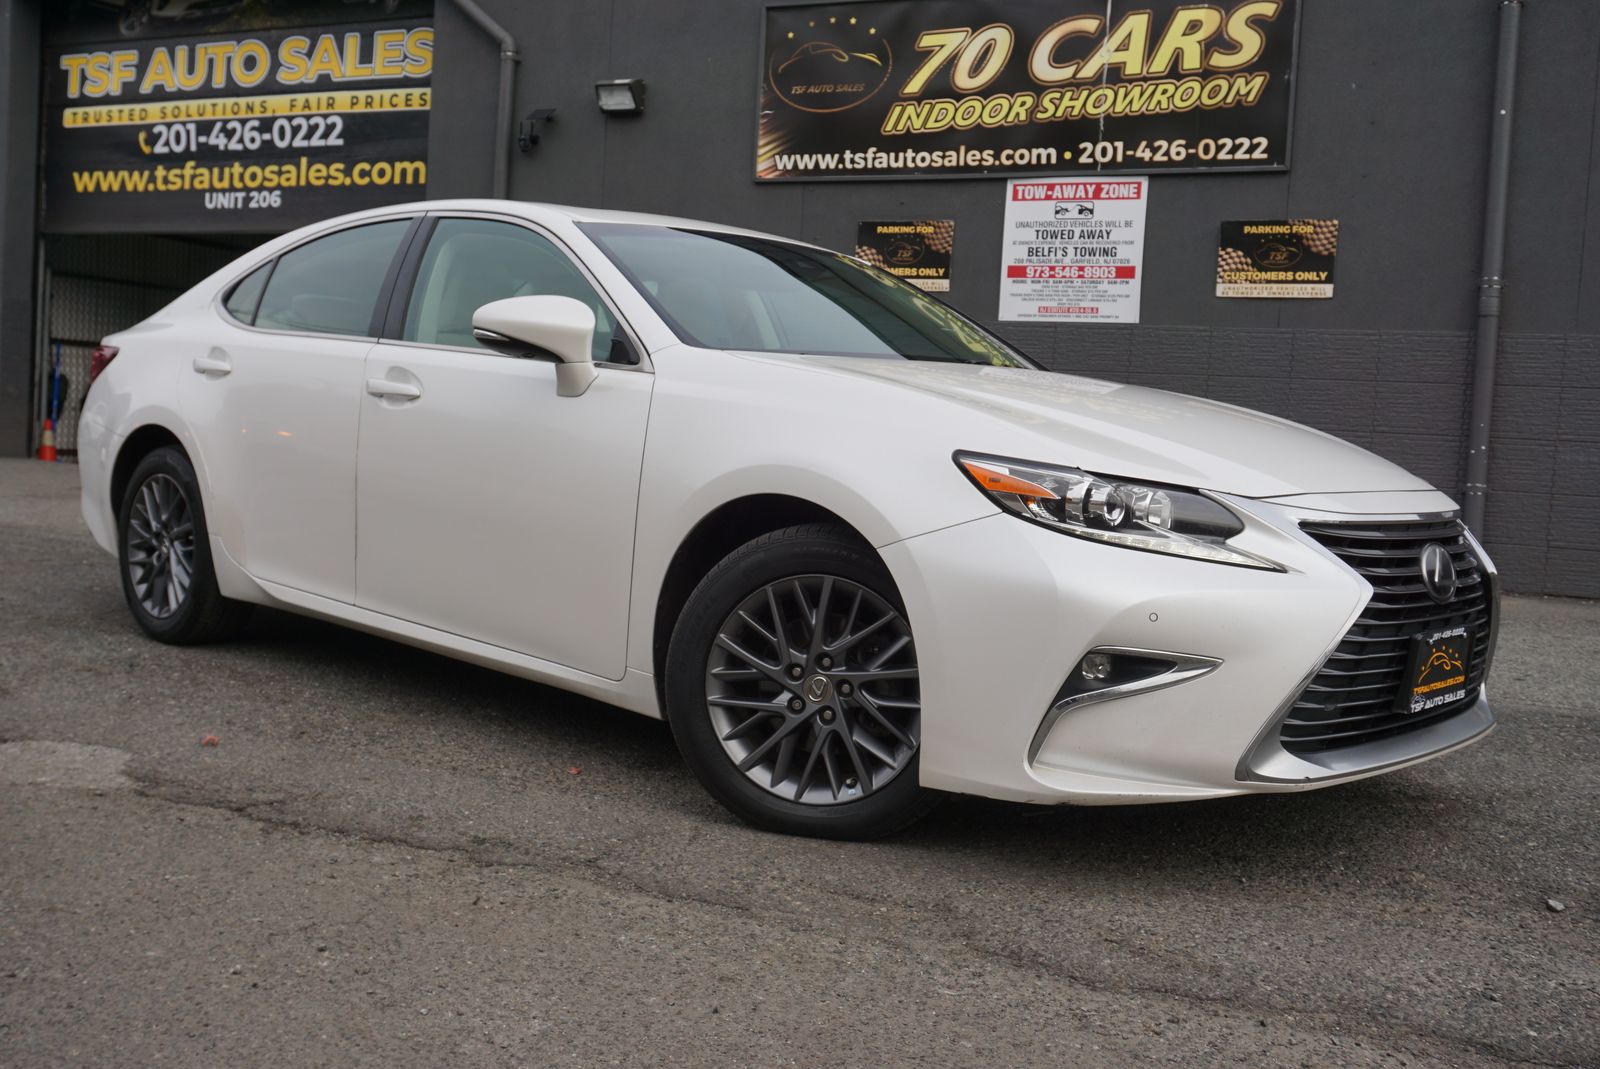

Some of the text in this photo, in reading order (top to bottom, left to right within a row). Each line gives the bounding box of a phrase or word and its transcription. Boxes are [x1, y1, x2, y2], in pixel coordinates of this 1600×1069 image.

[900, 0, 1285, 96] 70 CARS
[60, 27, 434, 98] TSF AUTO SALES
[791, 83, 865, 95] TSF AUTO SALES
[71, 92, 429, 124] TRUSTED SOLUTIONS, FAIR PRICES
[881, 71, 1270, 136] INDOOR SHOWROOM
[151, 115, 344, 154] 201-426-0222
[775, 136, 1269, 171] www.tsfautosales.com 201-426-0222
[72, 157, 426, 193] www.tsfautosales.com
[205, 190, 281, 209] UNIT 206
[1016, 184, 1138, 199] TOW-AWAY ZONE
[1124, 220, 1134, 228] BE
[1244, 225, 1314, 234] PARKING FOR
[1035, 229, 1112, 240] TOWED AWAY
[1027, 247, 1117, 257] BELFI'S TOWING
[918, 267, 945, 276] ONLY
[1026, 266, 1116, 278] 973-546-8903
[1223, 271, 1328, 281] CUSTOMERS ONLY
[1411, 689, 1466, 713] TSF AUTO SALES
